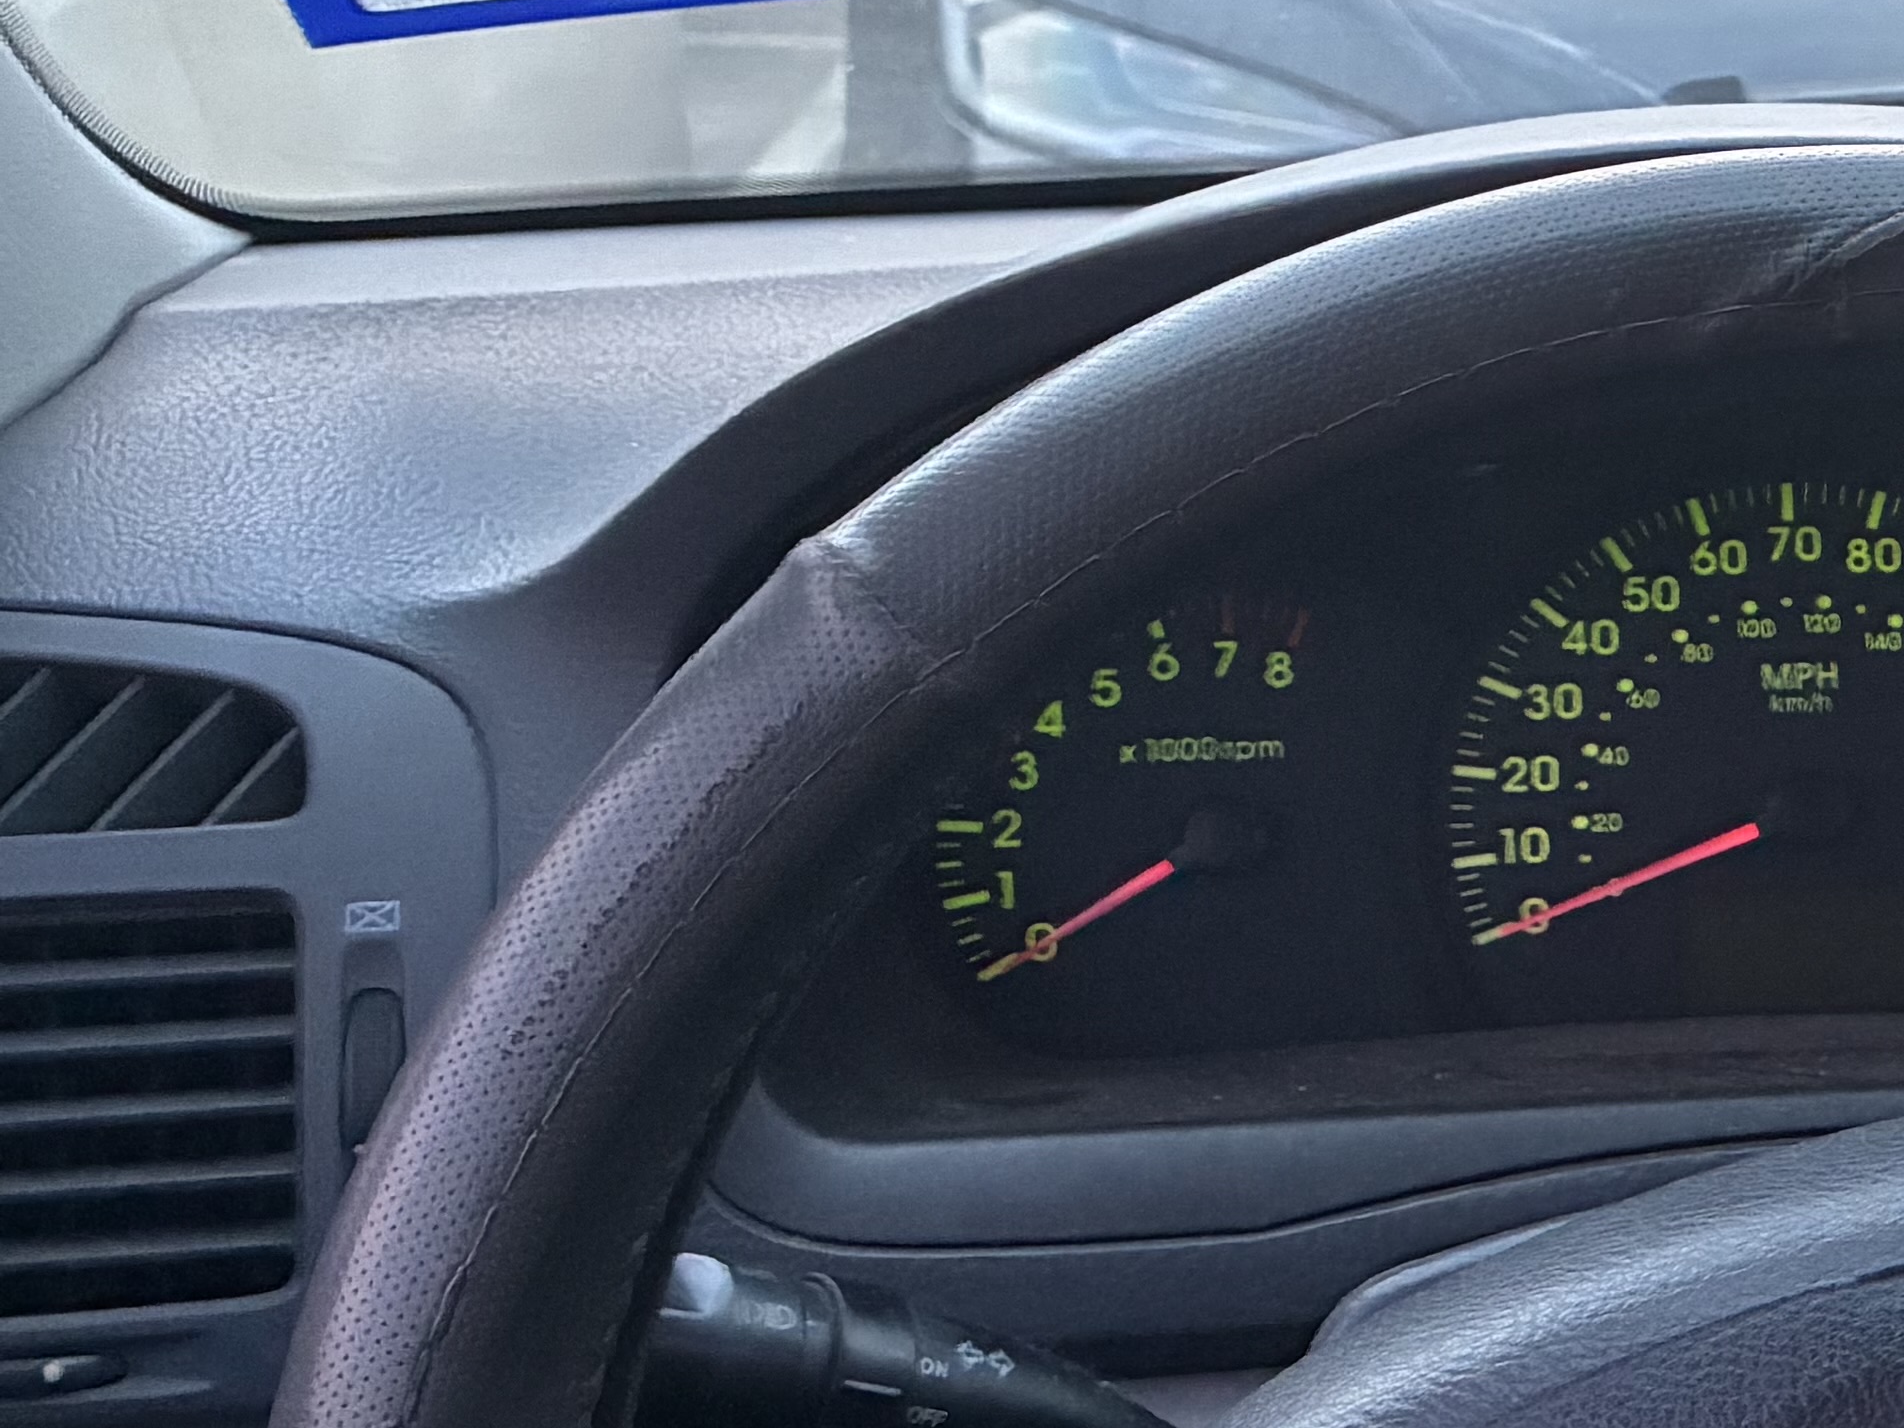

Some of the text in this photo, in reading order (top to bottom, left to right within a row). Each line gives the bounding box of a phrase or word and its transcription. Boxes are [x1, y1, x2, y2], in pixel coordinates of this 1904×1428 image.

[1691, 540, 1747, 576] 60
[1768, 526, 1822, 561] 70
[1846, 538, 1901, 573] 80
[1622, 576, 1680, 612] 50
[1562, 620, 1619, 655] 40
[1147, 642, 1180, 681] 6
[1214, 641, 1239, 677] 7
[1264, 652, 1294, 688] 8
[1760, 661, 1839, 690] MPH
[1090, 668, 1122, 707] 5
[1526, 683, 1583, 720] 30
[1034, 700, 1065, 737] 4
[1008, 750, 1039, 790] 3
[1503, 755, 1560, 793] 20
[992, 809, 1022, 848] 2
[1591, 812, 1622, 833] 20
[1501, 828, 1550, 864] 10
[996, 871, 1015, 909] 1
[1519, 897, 1551, 933] 0
[1024, 922, 1057, 962] 0
[920, 1356, 949, 1378] ON
